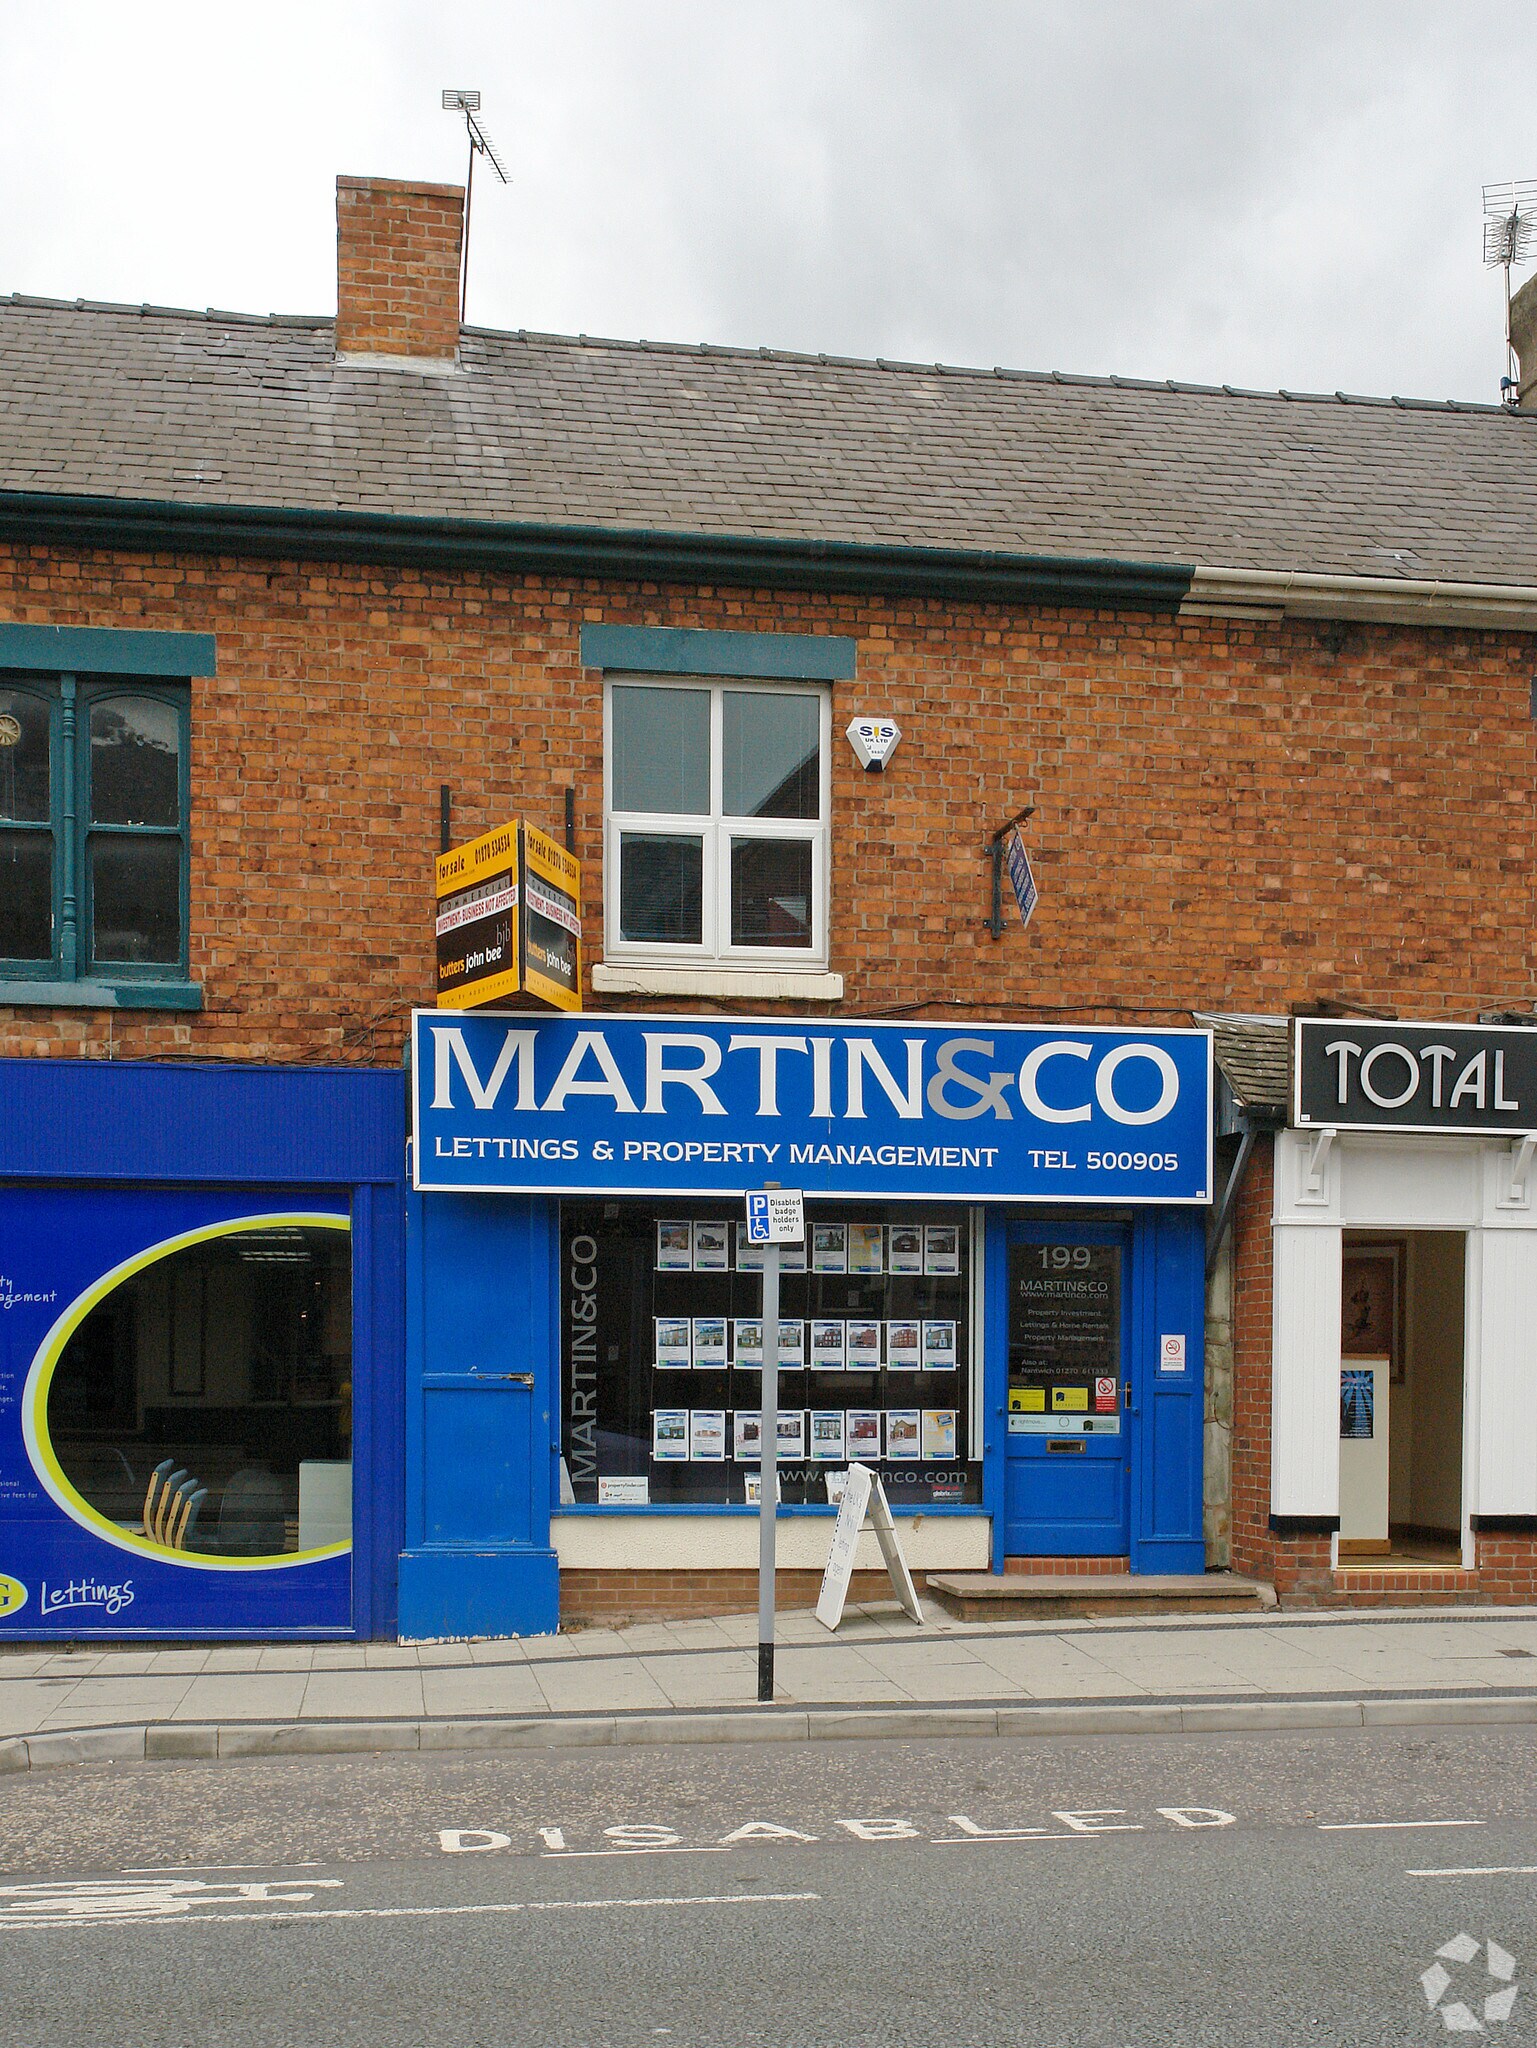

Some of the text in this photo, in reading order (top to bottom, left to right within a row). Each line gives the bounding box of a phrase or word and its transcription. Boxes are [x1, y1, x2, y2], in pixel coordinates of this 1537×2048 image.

[439, 863, 449, 880] for
[450, 854, 465, 876] sale
[475, 842, 491, 865] 01270
[535, 839, 546, 859] sale
[462, 901, 484, 922] BUSINESS
[485, 897, 495, 914] NOT
[495, 888, 516, 910] AFFECTED
[496, 920, 511, 951] bjb
[439, 946, 502, 979] butters john bee
[546, 948, 560, 970] john
[560, 956, 572, 976] bee
[429, 1027, 1180, 1125] MARTIN&CO
[1325, 1040, 1519, 1110] TOTAL
[435, 1137, 1179, 1171] LETTINGS & PROPERTY MANAGEMENT TEL 500905
[753, 1197, 766, 1215] P
[775, 1208, 796, 1216] badge
[1038, 1246, 1091, 1270] 199
[1020, 1280, 1108, 1293] MARTIN&CO
[1020, 1291, 1109, 1299] www.martinco.com
[1020, 1322, 1050, 1330] Lettings
[1027, 1309, 1102, 1317] Property Investment
[1024, 1333, 1104, 1342] Property Management
[570, 1235, 598, 1483] MARTIN&CO
[1021, 1367, 1055, 1375] Nantwich
[1055, 1367, 1078, 1375] 01270
[41, 1577, 135, 1615] Lettings
[437, 1807, 1238, 1852] DISABLED
